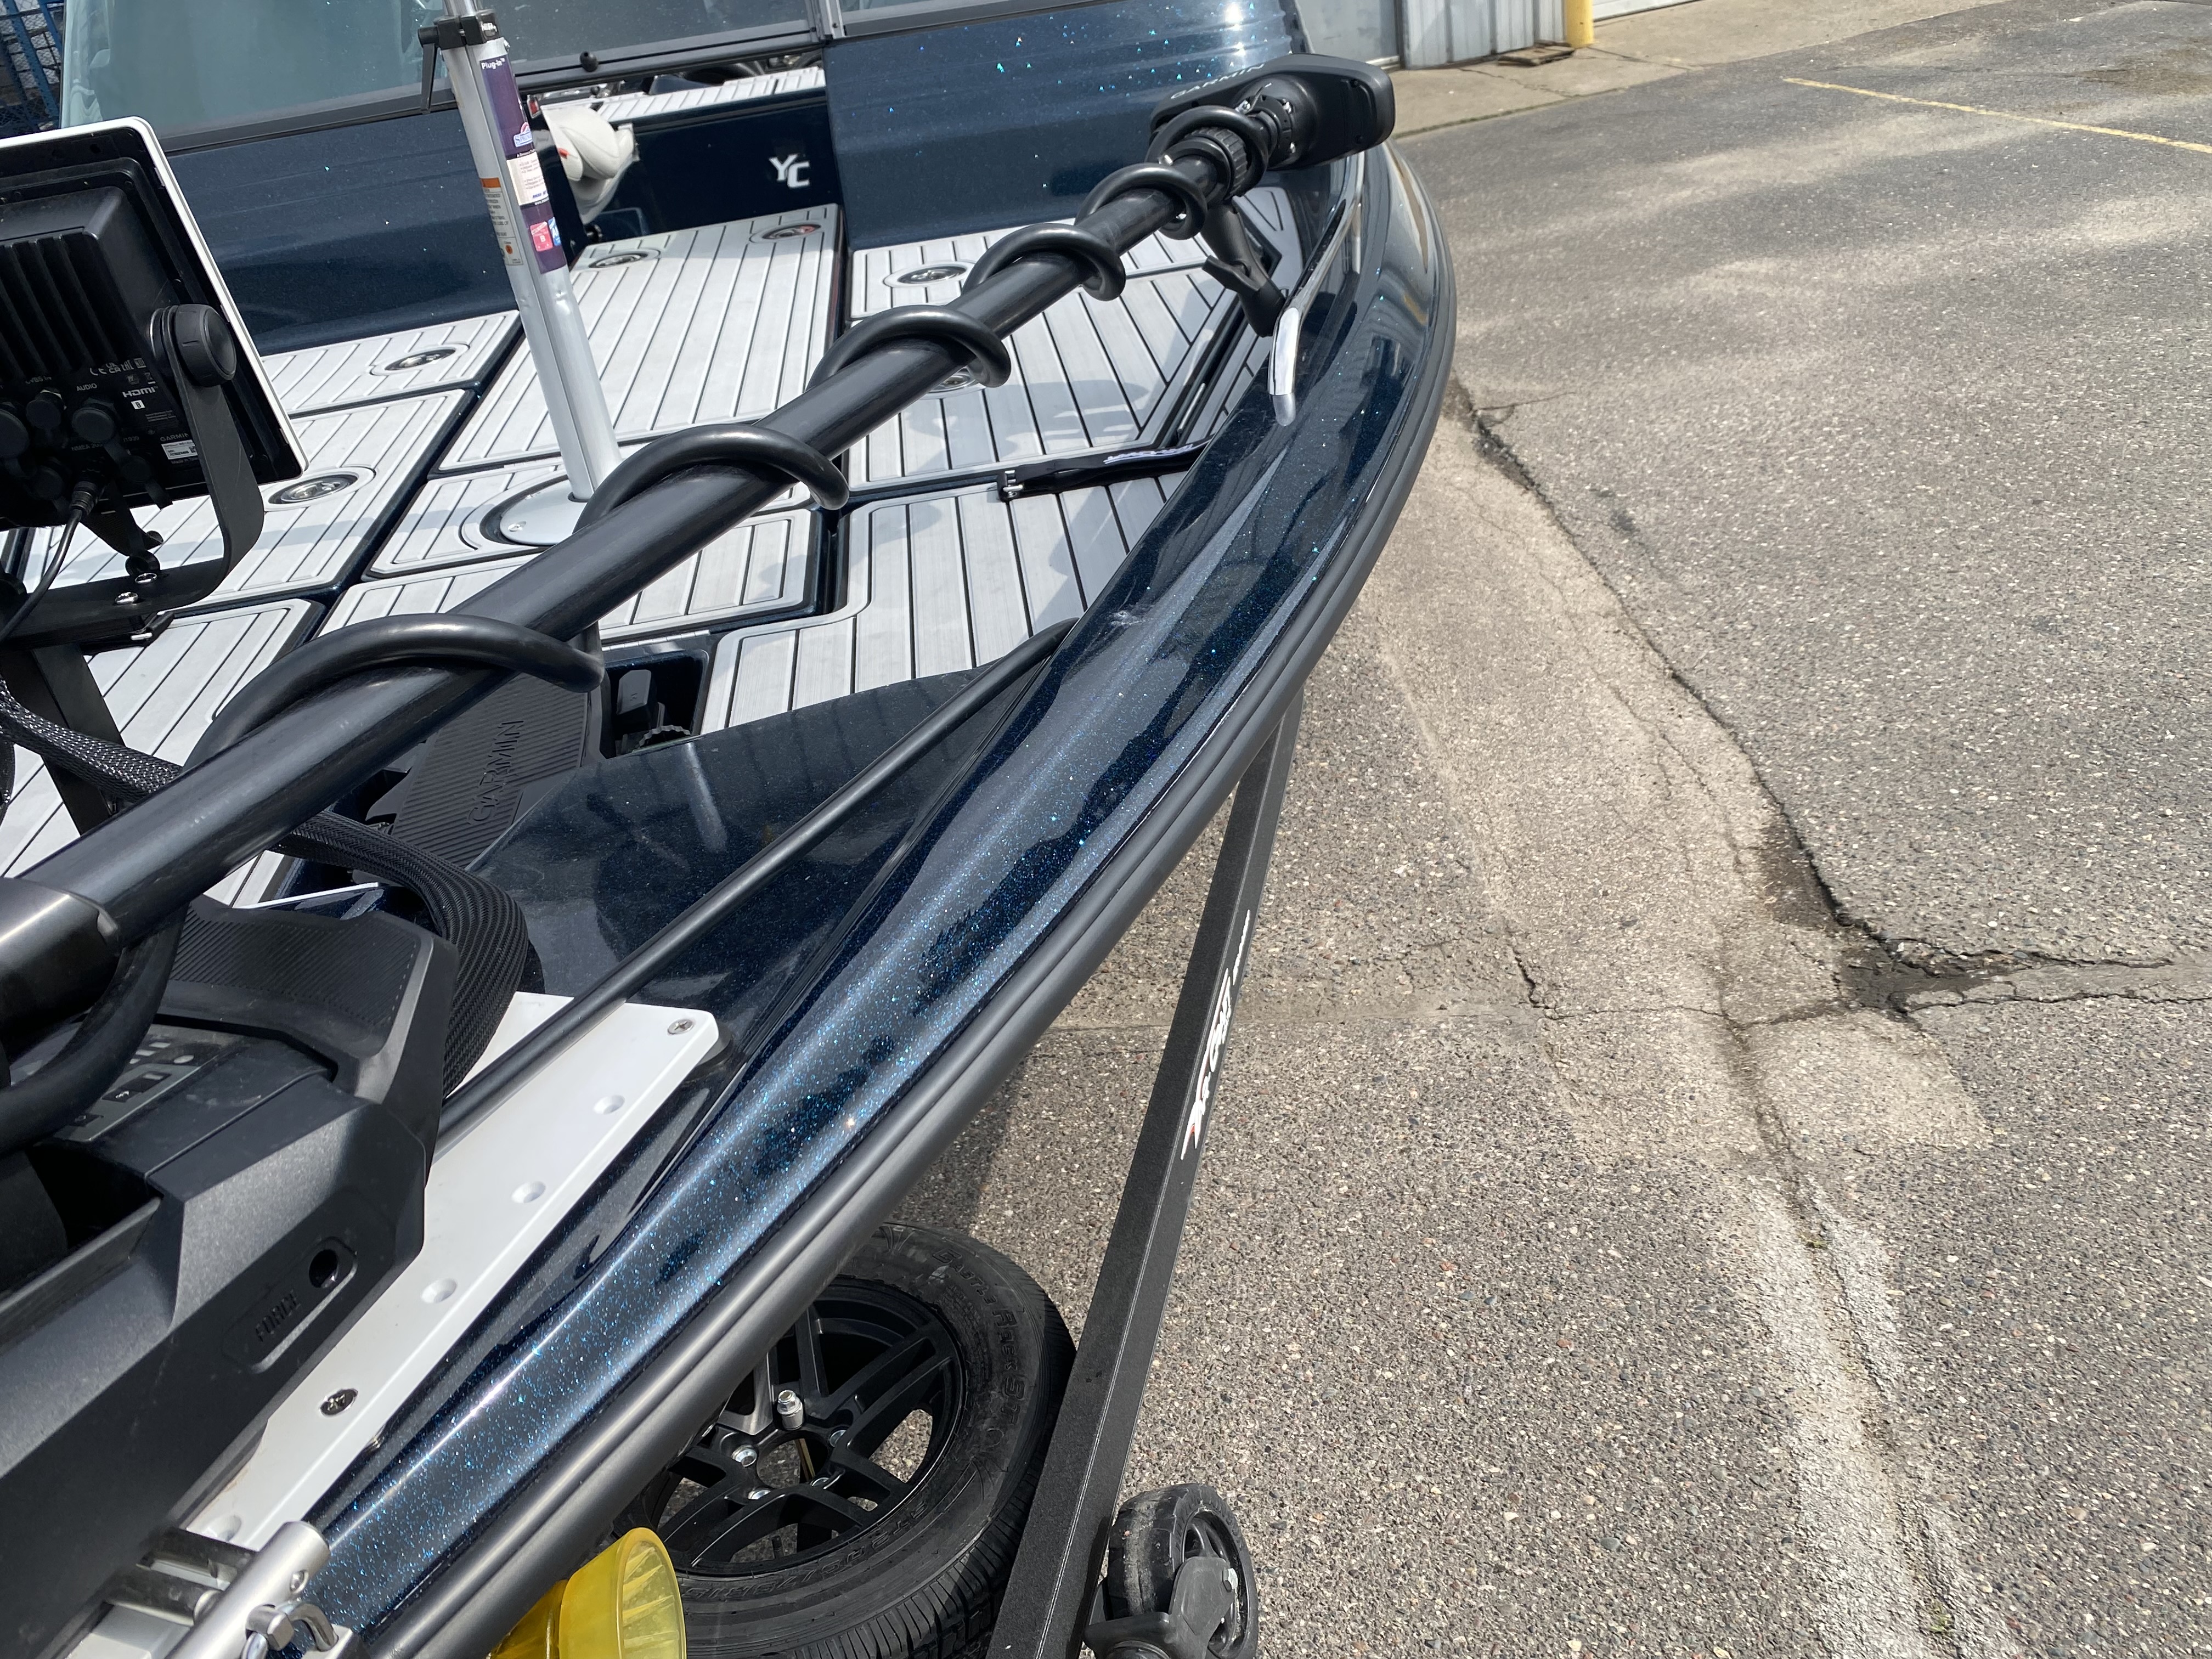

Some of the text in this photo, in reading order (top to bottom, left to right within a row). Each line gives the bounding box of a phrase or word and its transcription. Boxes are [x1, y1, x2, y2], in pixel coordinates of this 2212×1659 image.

[769, 154, 810, 189] YC
[76, 383, 98, 392] AUDIO
[122, 387, 156, 398] HDMI
[465, 719, 524, 825] GARMIN
